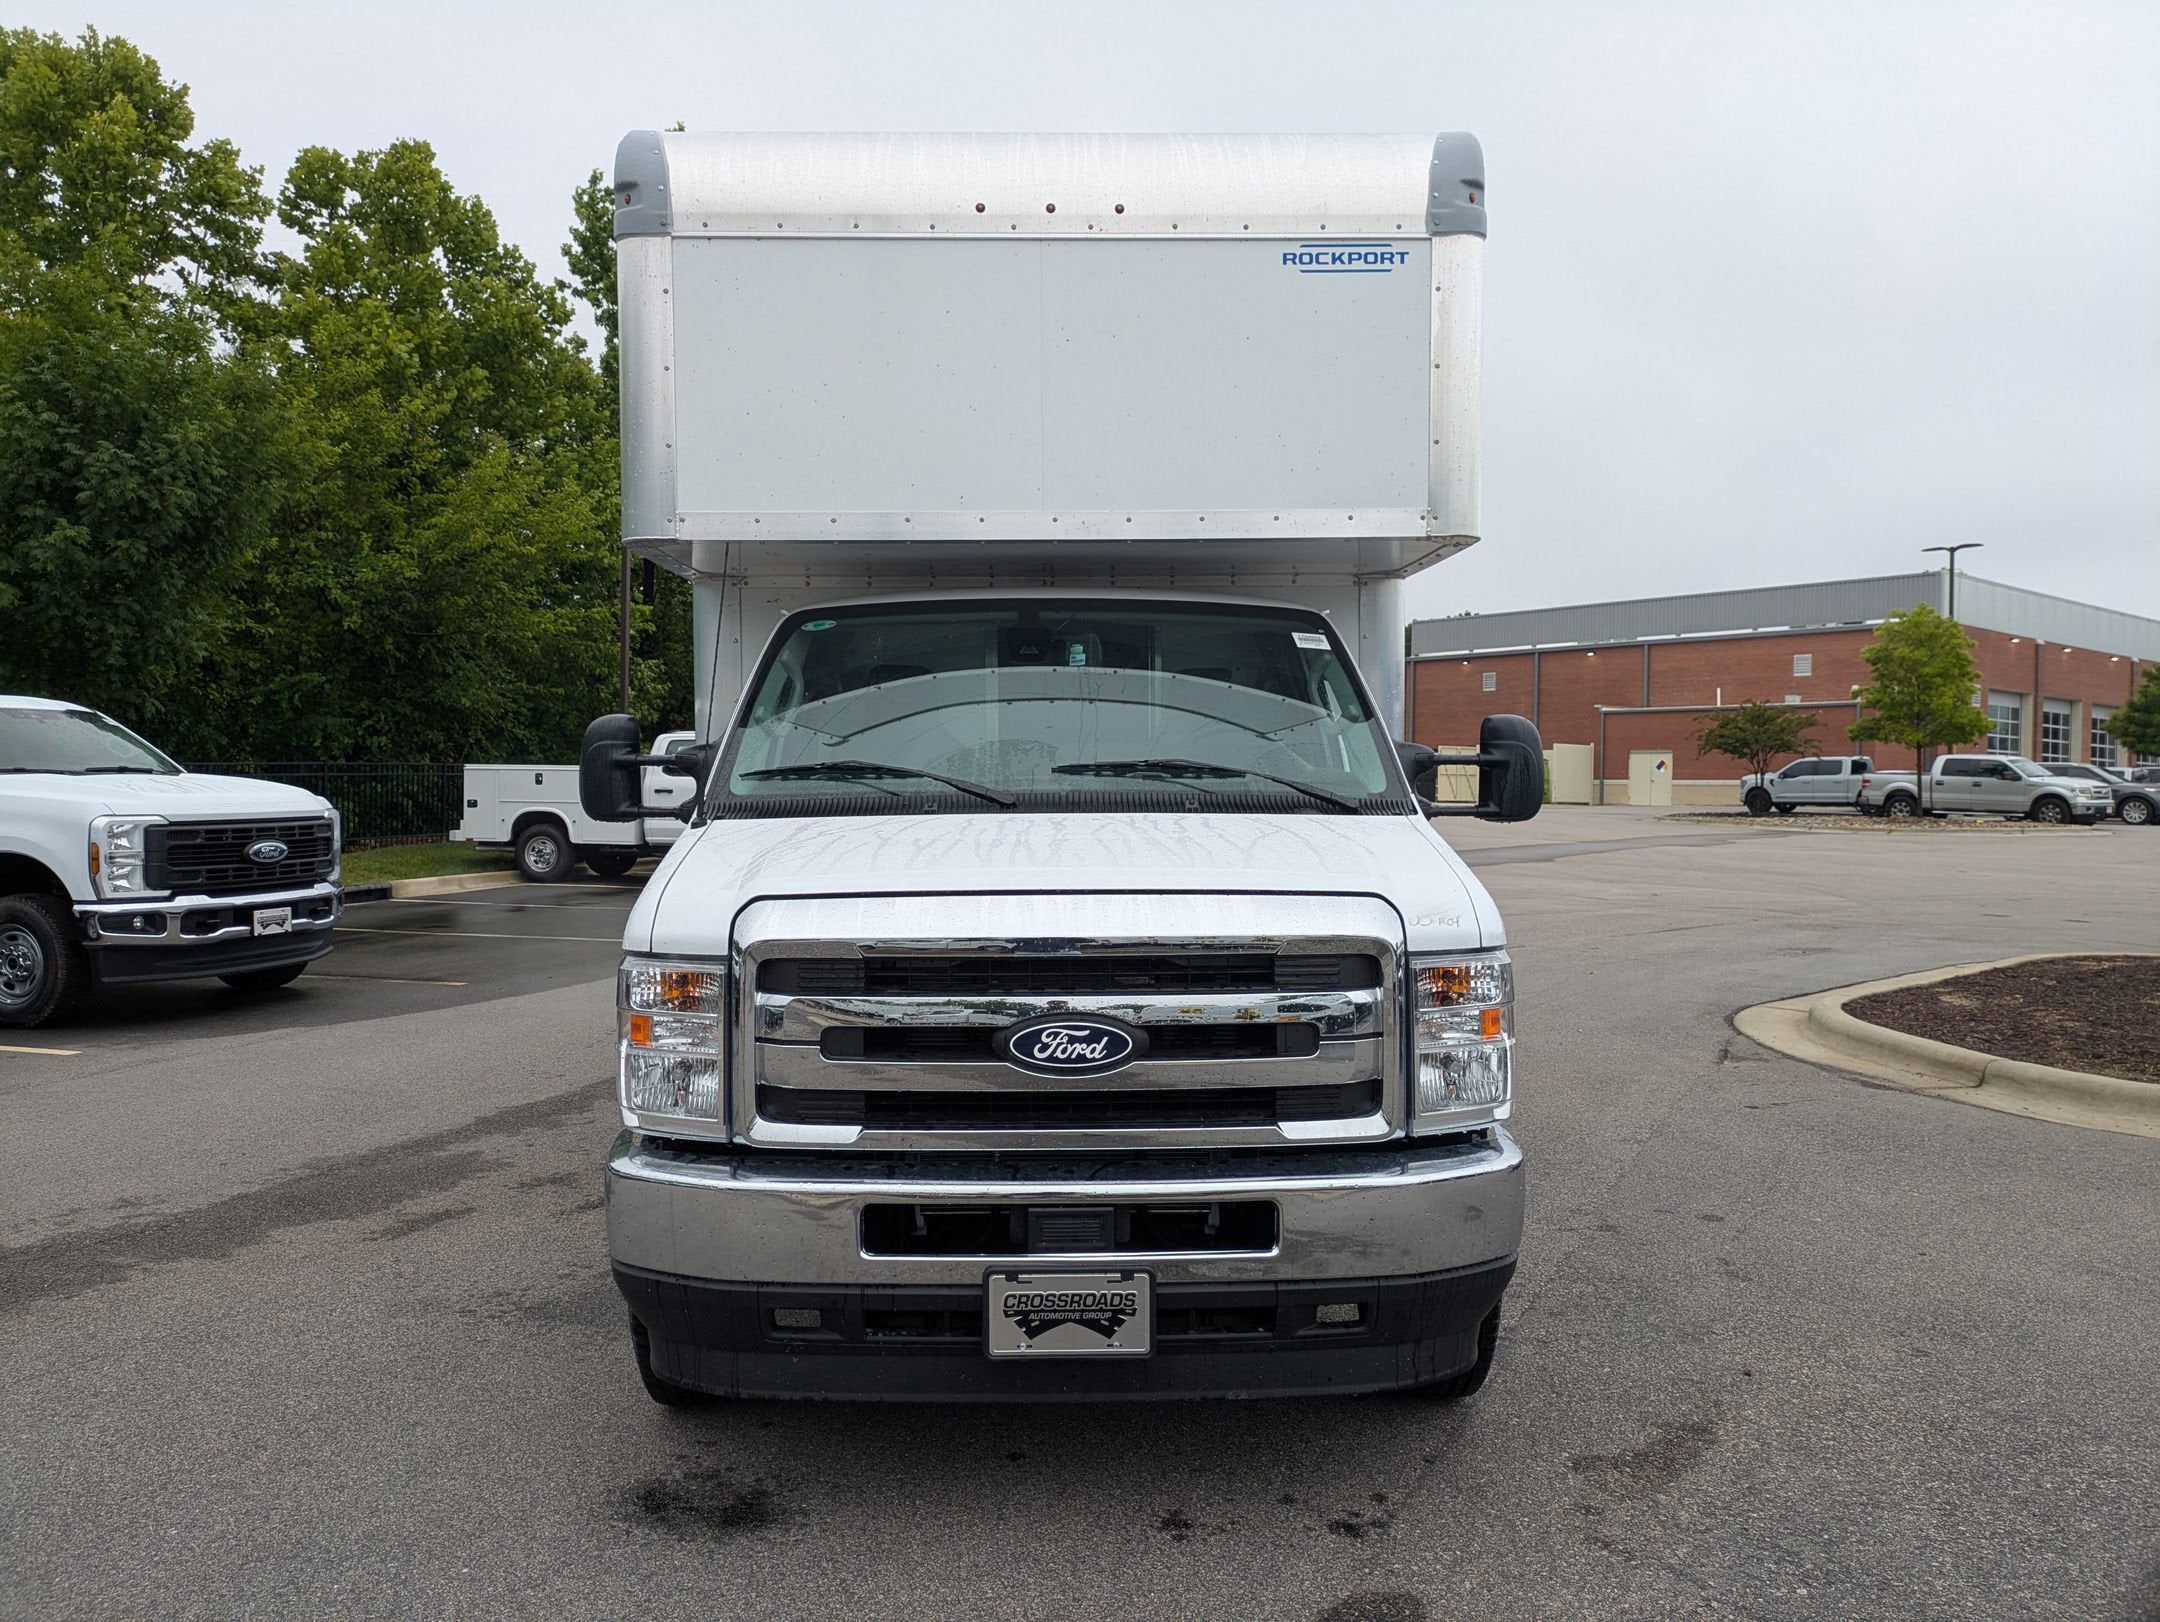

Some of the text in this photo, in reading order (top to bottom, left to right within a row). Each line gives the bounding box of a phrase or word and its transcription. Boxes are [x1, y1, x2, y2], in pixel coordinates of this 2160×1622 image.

[1282, 251, 1410, 266] ROCKPORT
[259, 846, 281, 858] Ford
[1033, 1028, 1109, 1059] Ford
[1003, 1291, 1138, 1309] CROSSROADS
[1028, 1311, 1112, 1320] AUTOMOTIVE GROUP
